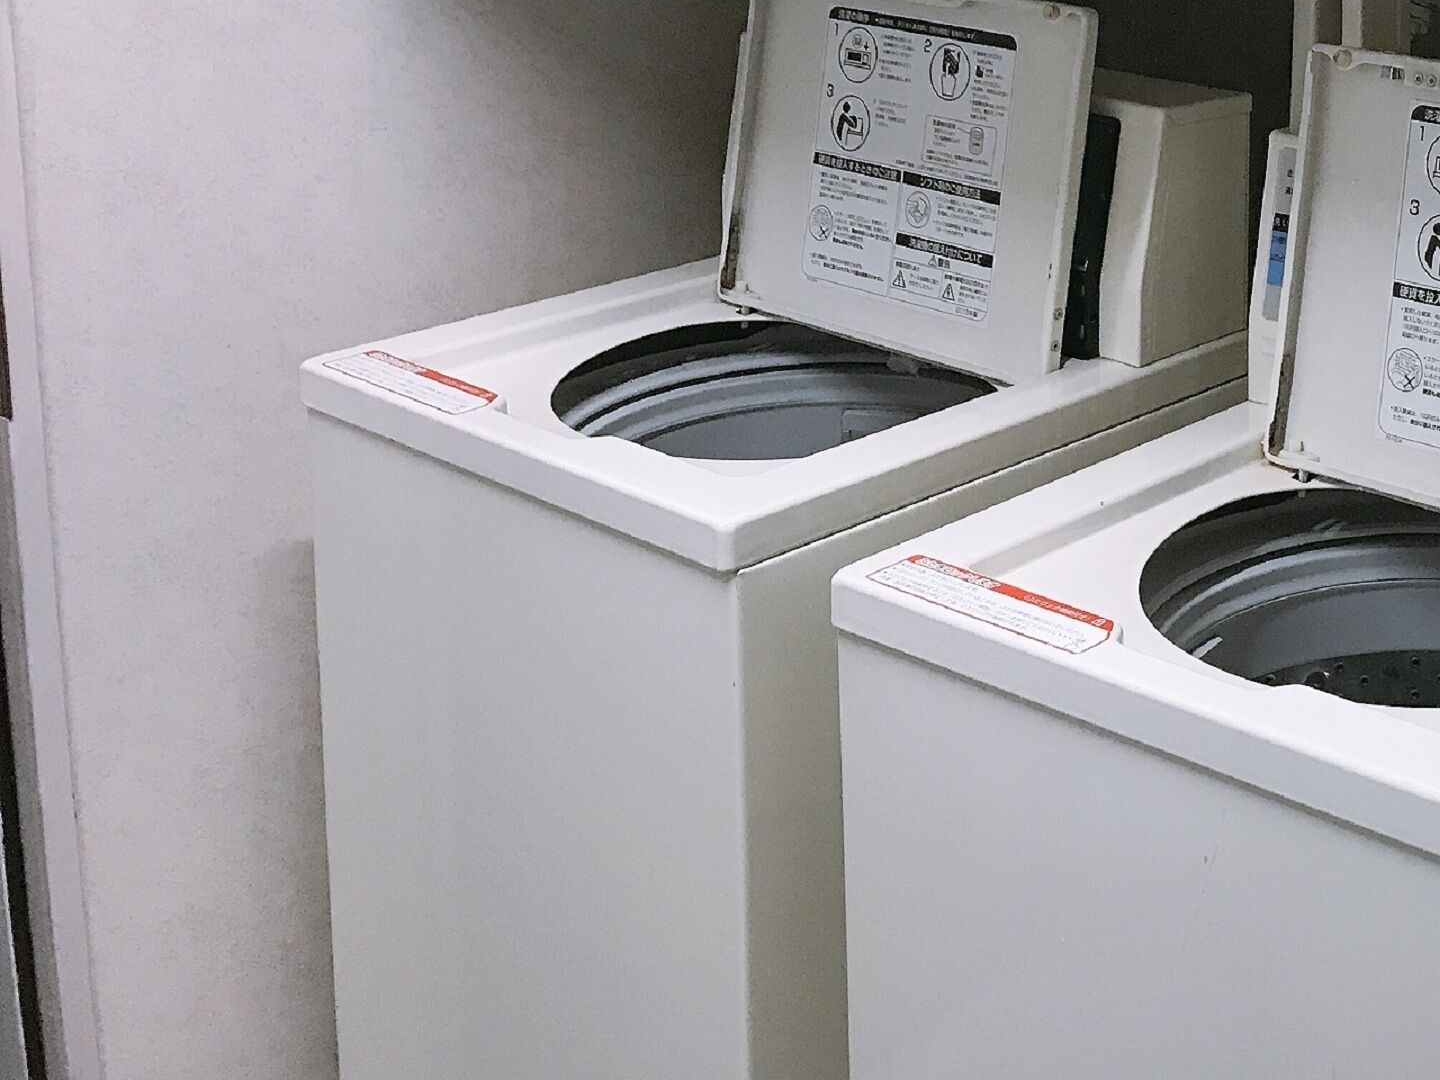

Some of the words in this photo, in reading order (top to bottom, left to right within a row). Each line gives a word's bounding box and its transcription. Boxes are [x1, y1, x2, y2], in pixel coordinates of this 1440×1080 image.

[834, 23, 840, 36] 1
[923, 39, 932, 53] 2
[825, 83, 835, 98] 3
[1418, 126, 1425, 143] 1
[1409, 199, 1420, 216] 3
